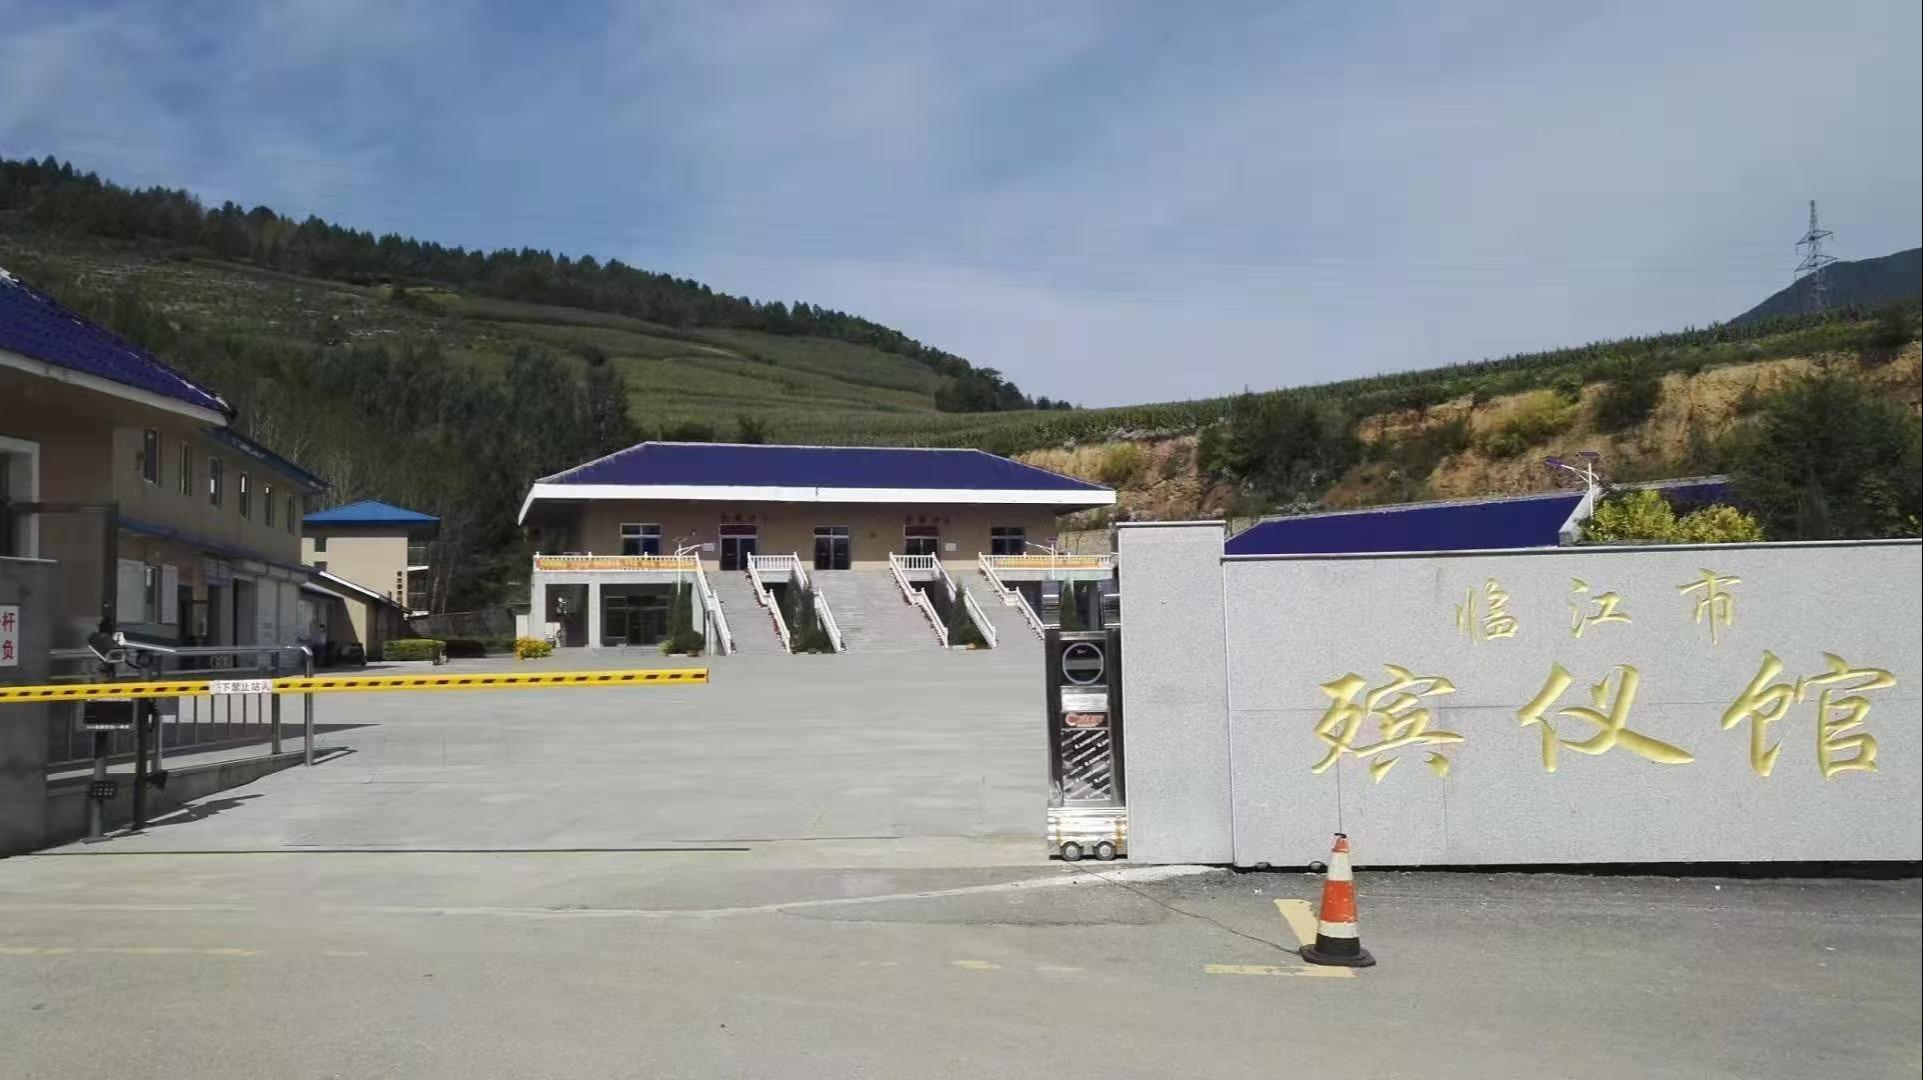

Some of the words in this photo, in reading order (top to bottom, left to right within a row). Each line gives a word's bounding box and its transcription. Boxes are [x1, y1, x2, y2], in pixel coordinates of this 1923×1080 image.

[1455, 568, 1743, 645] 临江市
[1312, 649, 1897, 783] 殡仪馆
